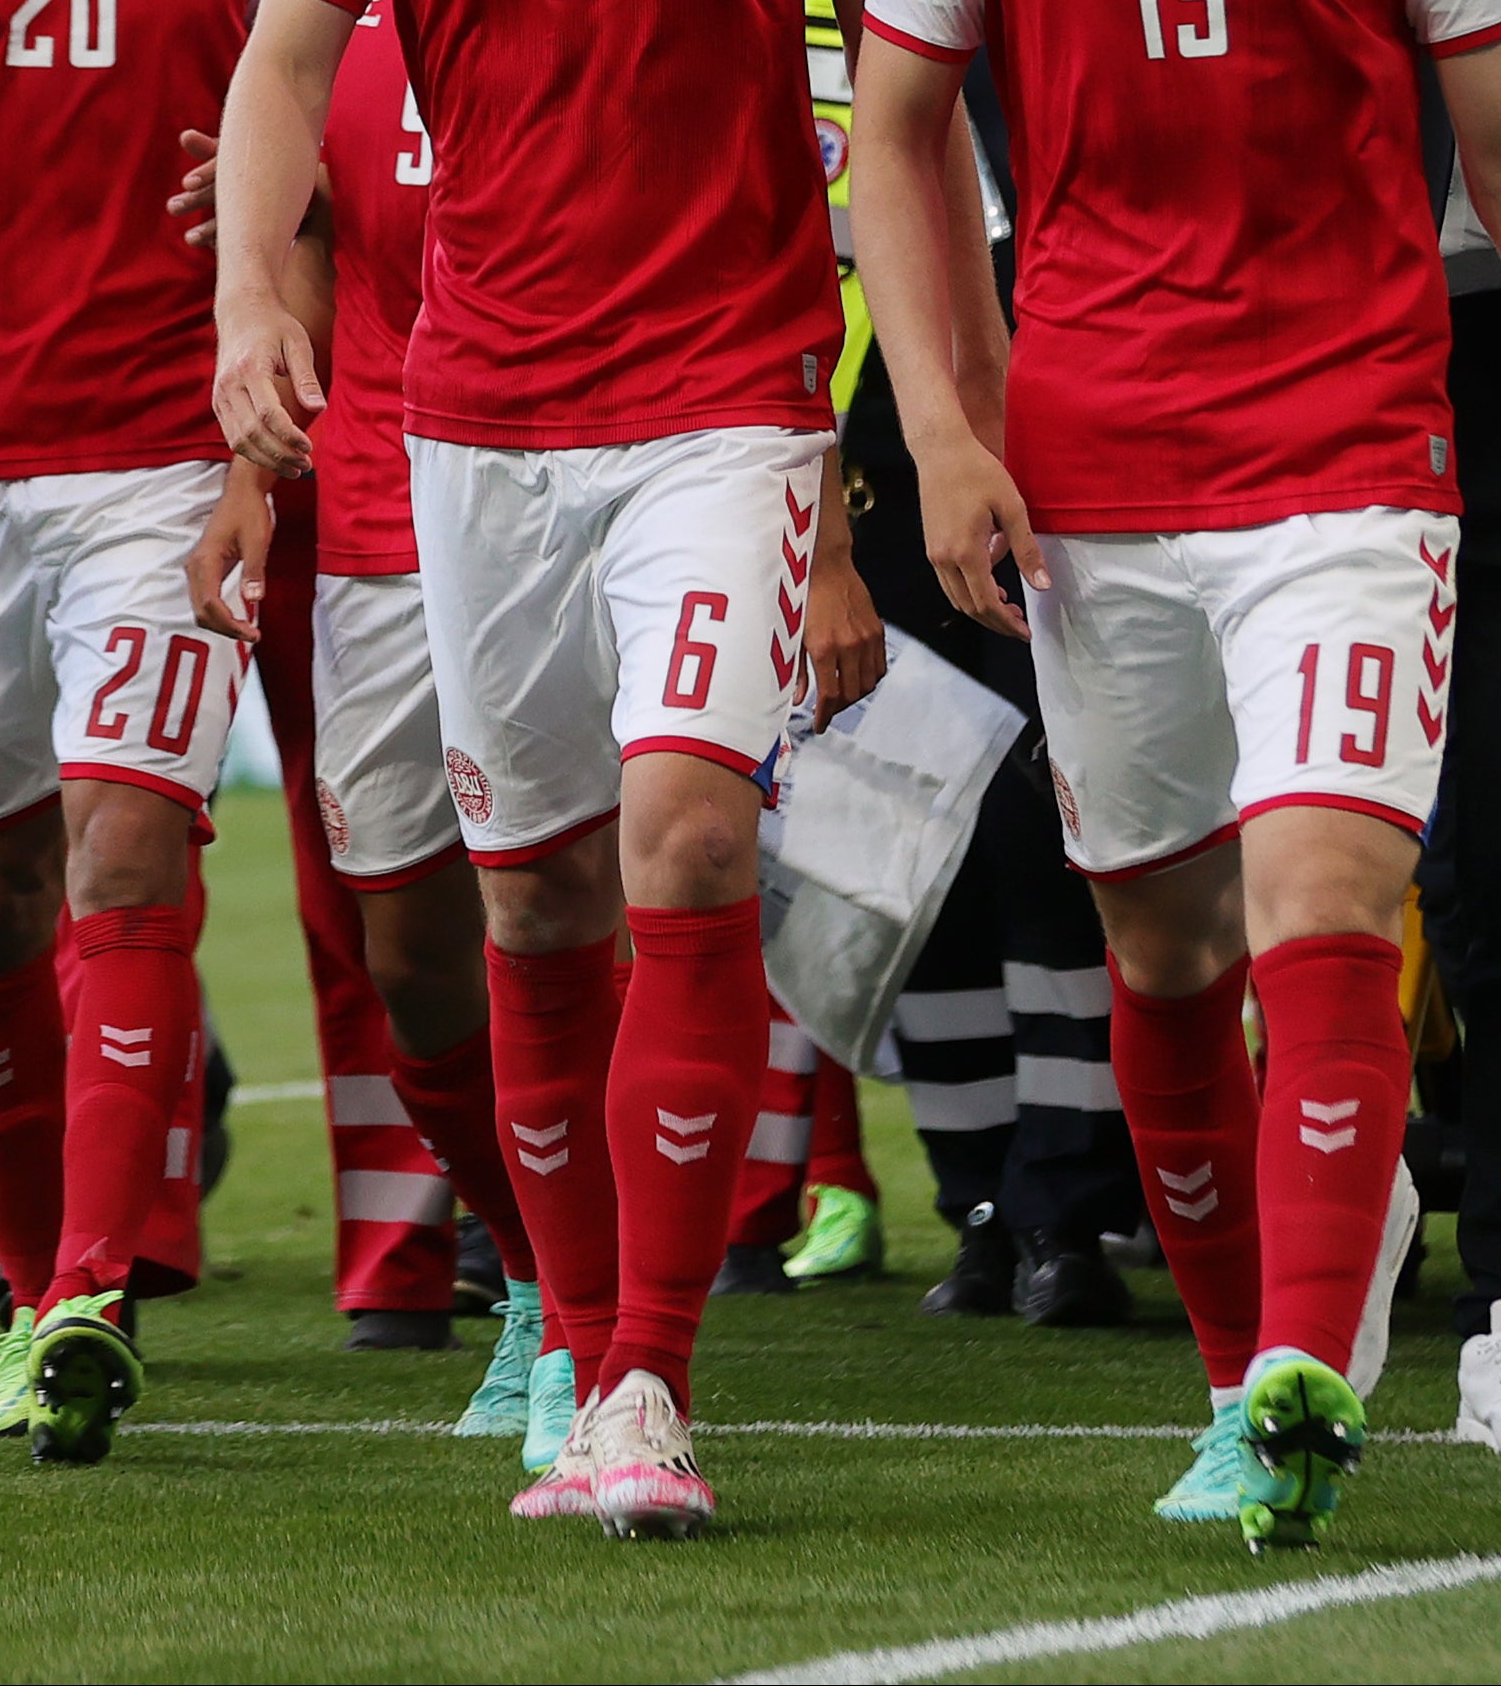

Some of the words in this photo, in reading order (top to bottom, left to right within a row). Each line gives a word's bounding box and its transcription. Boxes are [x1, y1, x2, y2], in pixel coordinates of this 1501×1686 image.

[86, 626, 210, 756] 20
[662, 590, 728, 709] 6
[1296, 642, 1395, 769] 19
[454, 772, 483, 797] DBU
